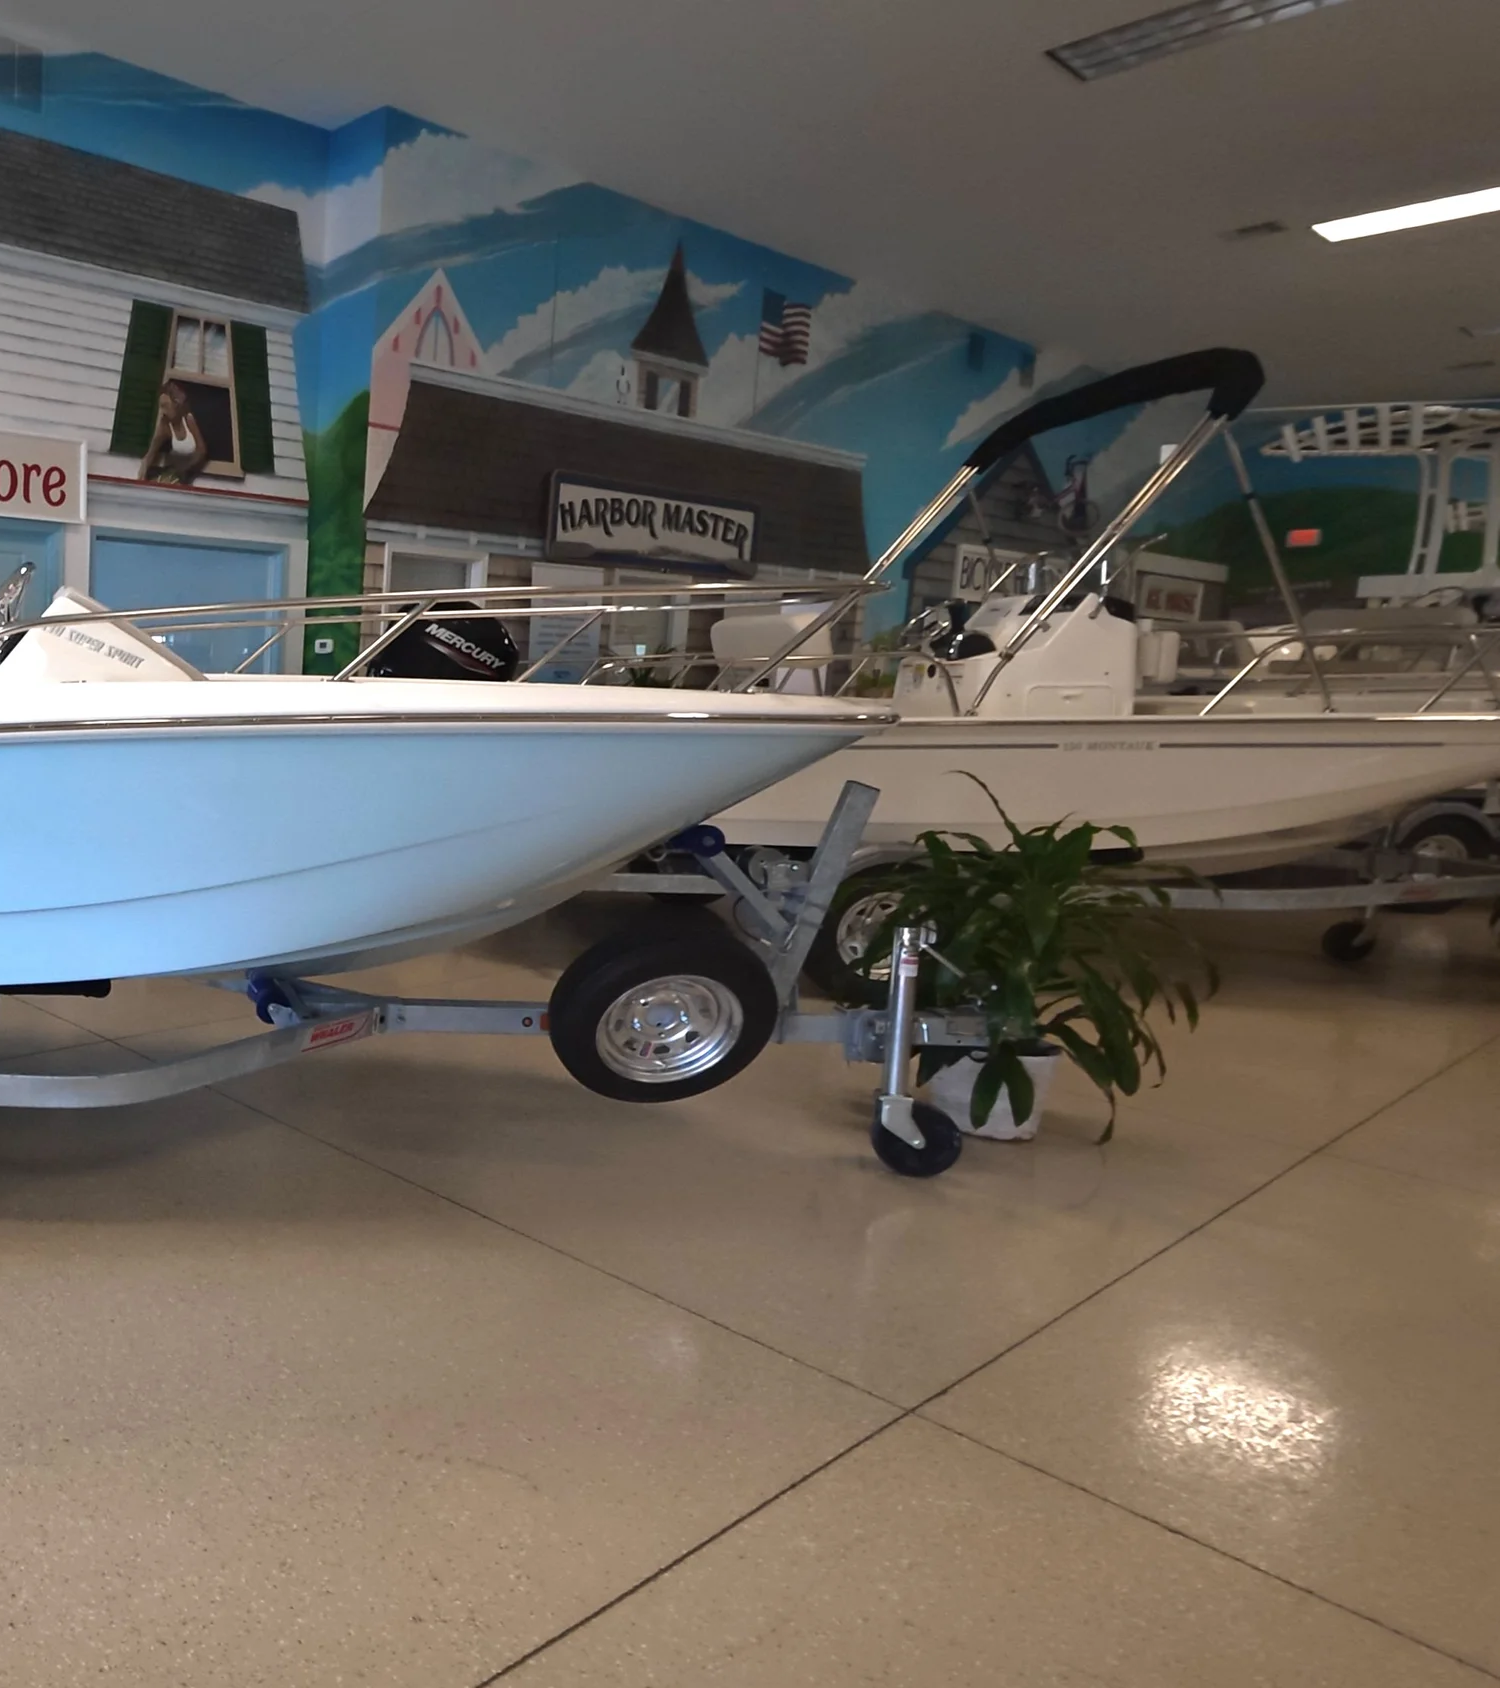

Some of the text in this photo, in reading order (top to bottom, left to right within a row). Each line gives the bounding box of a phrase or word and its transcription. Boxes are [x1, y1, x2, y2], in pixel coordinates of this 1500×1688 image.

[559, 498, 748, 559] HARBOR MASTER
[425, 623, 506, 669] MERCURY
